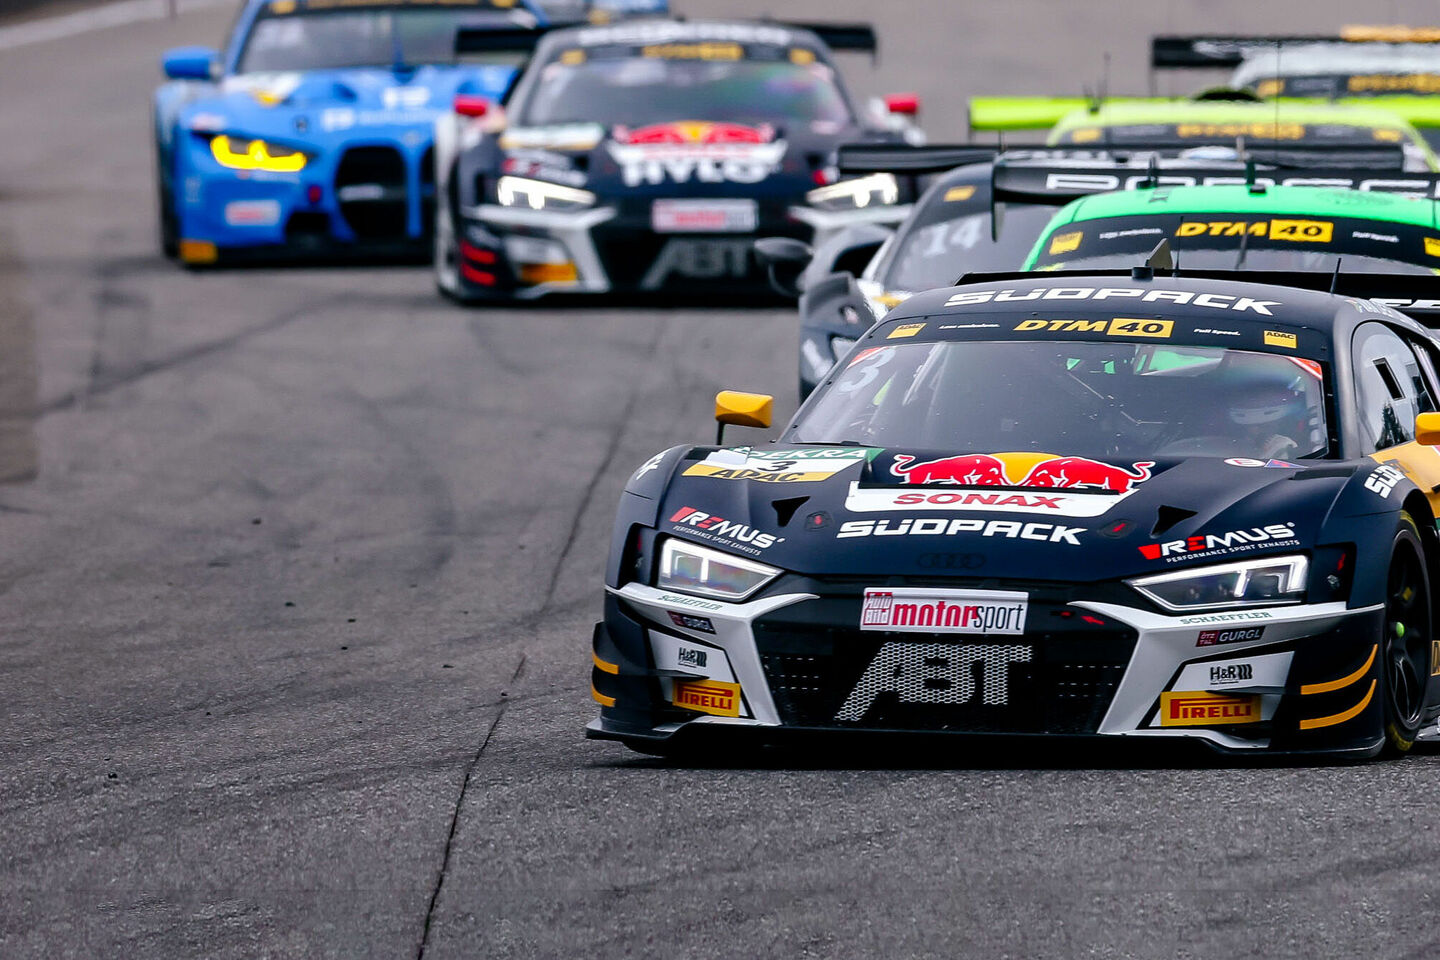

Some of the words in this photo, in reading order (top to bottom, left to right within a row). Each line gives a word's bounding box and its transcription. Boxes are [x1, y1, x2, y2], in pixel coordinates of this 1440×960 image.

[924, 218, 982, 257] 14
[1175, 222, 1267, 237] DTM
[1279, 225, 1322, 236] 40
[944, 288, 1283, 316] SÜDPACK
[1013, 320, 1108, 332] DTM
[1117, 322, 1164, 334] 40
[1266, 331, 1295, 340] ADAC
[711, 468, 804, 482] ADAC
[758, 460, 796, 472] 3
[894, 493, 1068, 510] SONAX
[678, 511, 780, 549] REMUS
[836, 518, 1088, 546] SÜDPACK
[1161, 522, 1296, 556] REMUS
[1166, 549, 1228, 563] PERFORMANCE
[1229, 544, 1256, 553] SPORT
[1258, 539, 1300, 549] EXHAUSTS
[658, 595, 724, 611] SCHAEFFLER
[892, 600, 1024, 632] motorsport
[1180, 611, 1272, 625] SCHAEFFLER
[1219, 629, 1260, 642] GURGL
[834, 642, 1032, 722] ABT
[1210, 665, 1236, 681] H&R
[677, 683, 734, 710] PIRELLI
[1170, 696, 1252, 719] PIRELLI
